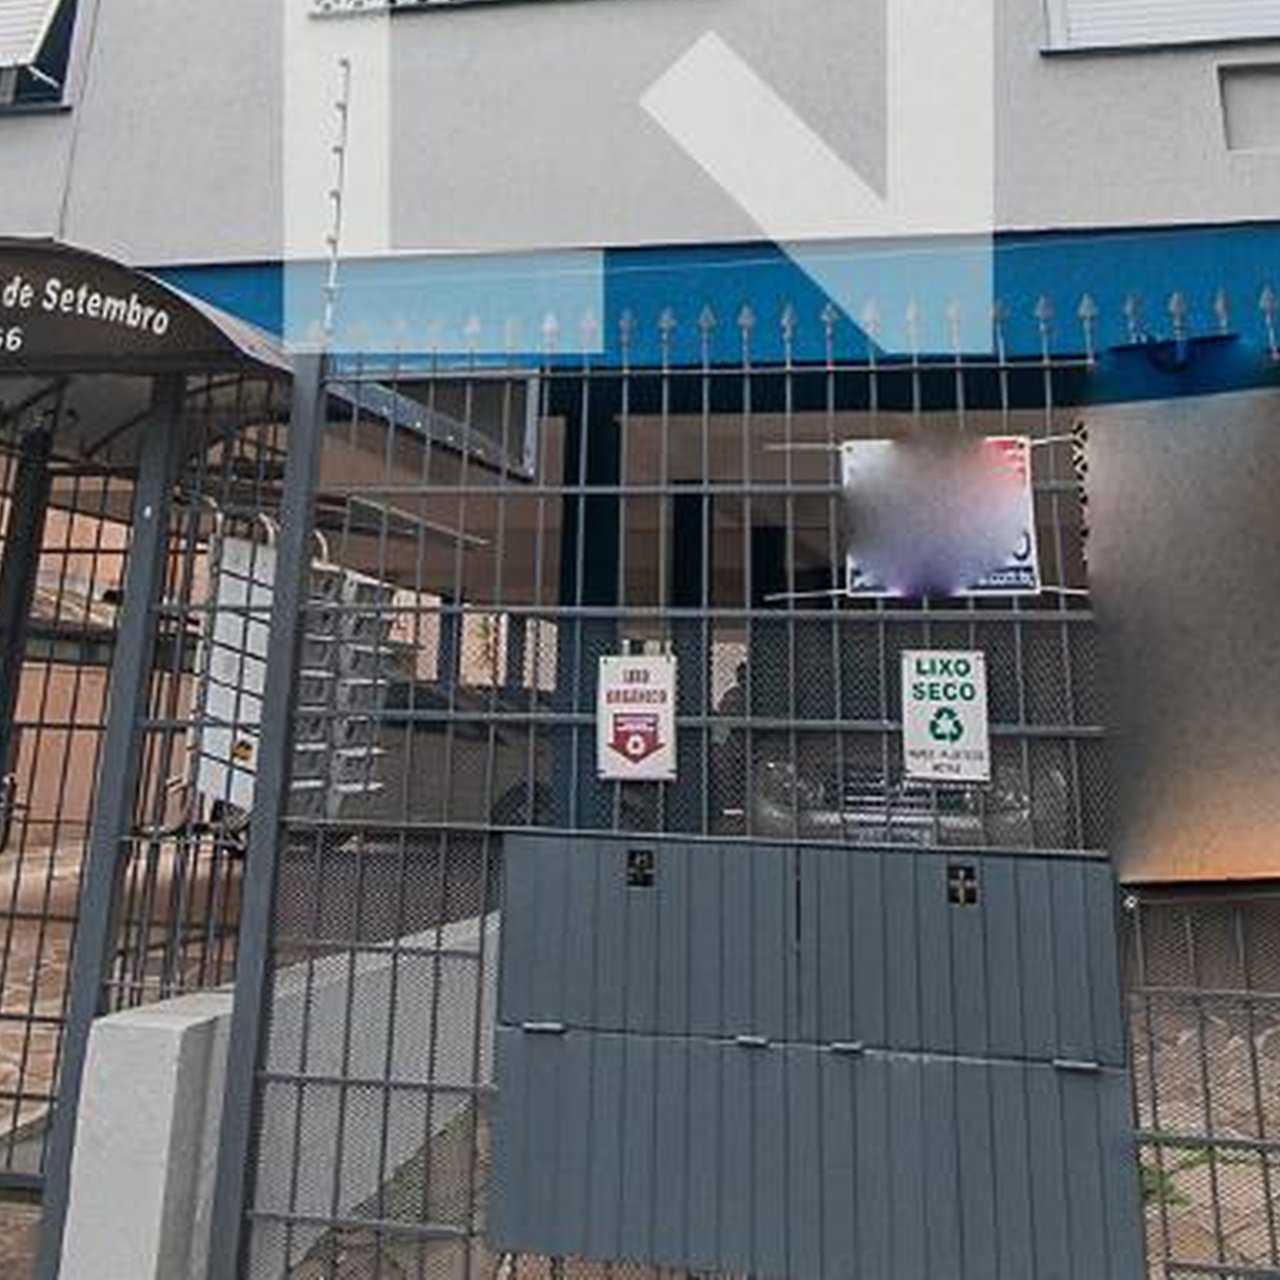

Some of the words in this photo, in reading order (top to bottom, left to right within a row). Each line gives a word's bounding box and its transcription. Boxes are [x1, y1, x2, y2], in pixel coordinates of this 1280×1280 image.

[2, 275, 34, 308] de
[41, 277, 170, 335] Setembro
[916, 658, 972, 677] LIXO
[912, 681, 976, 701] SECO
